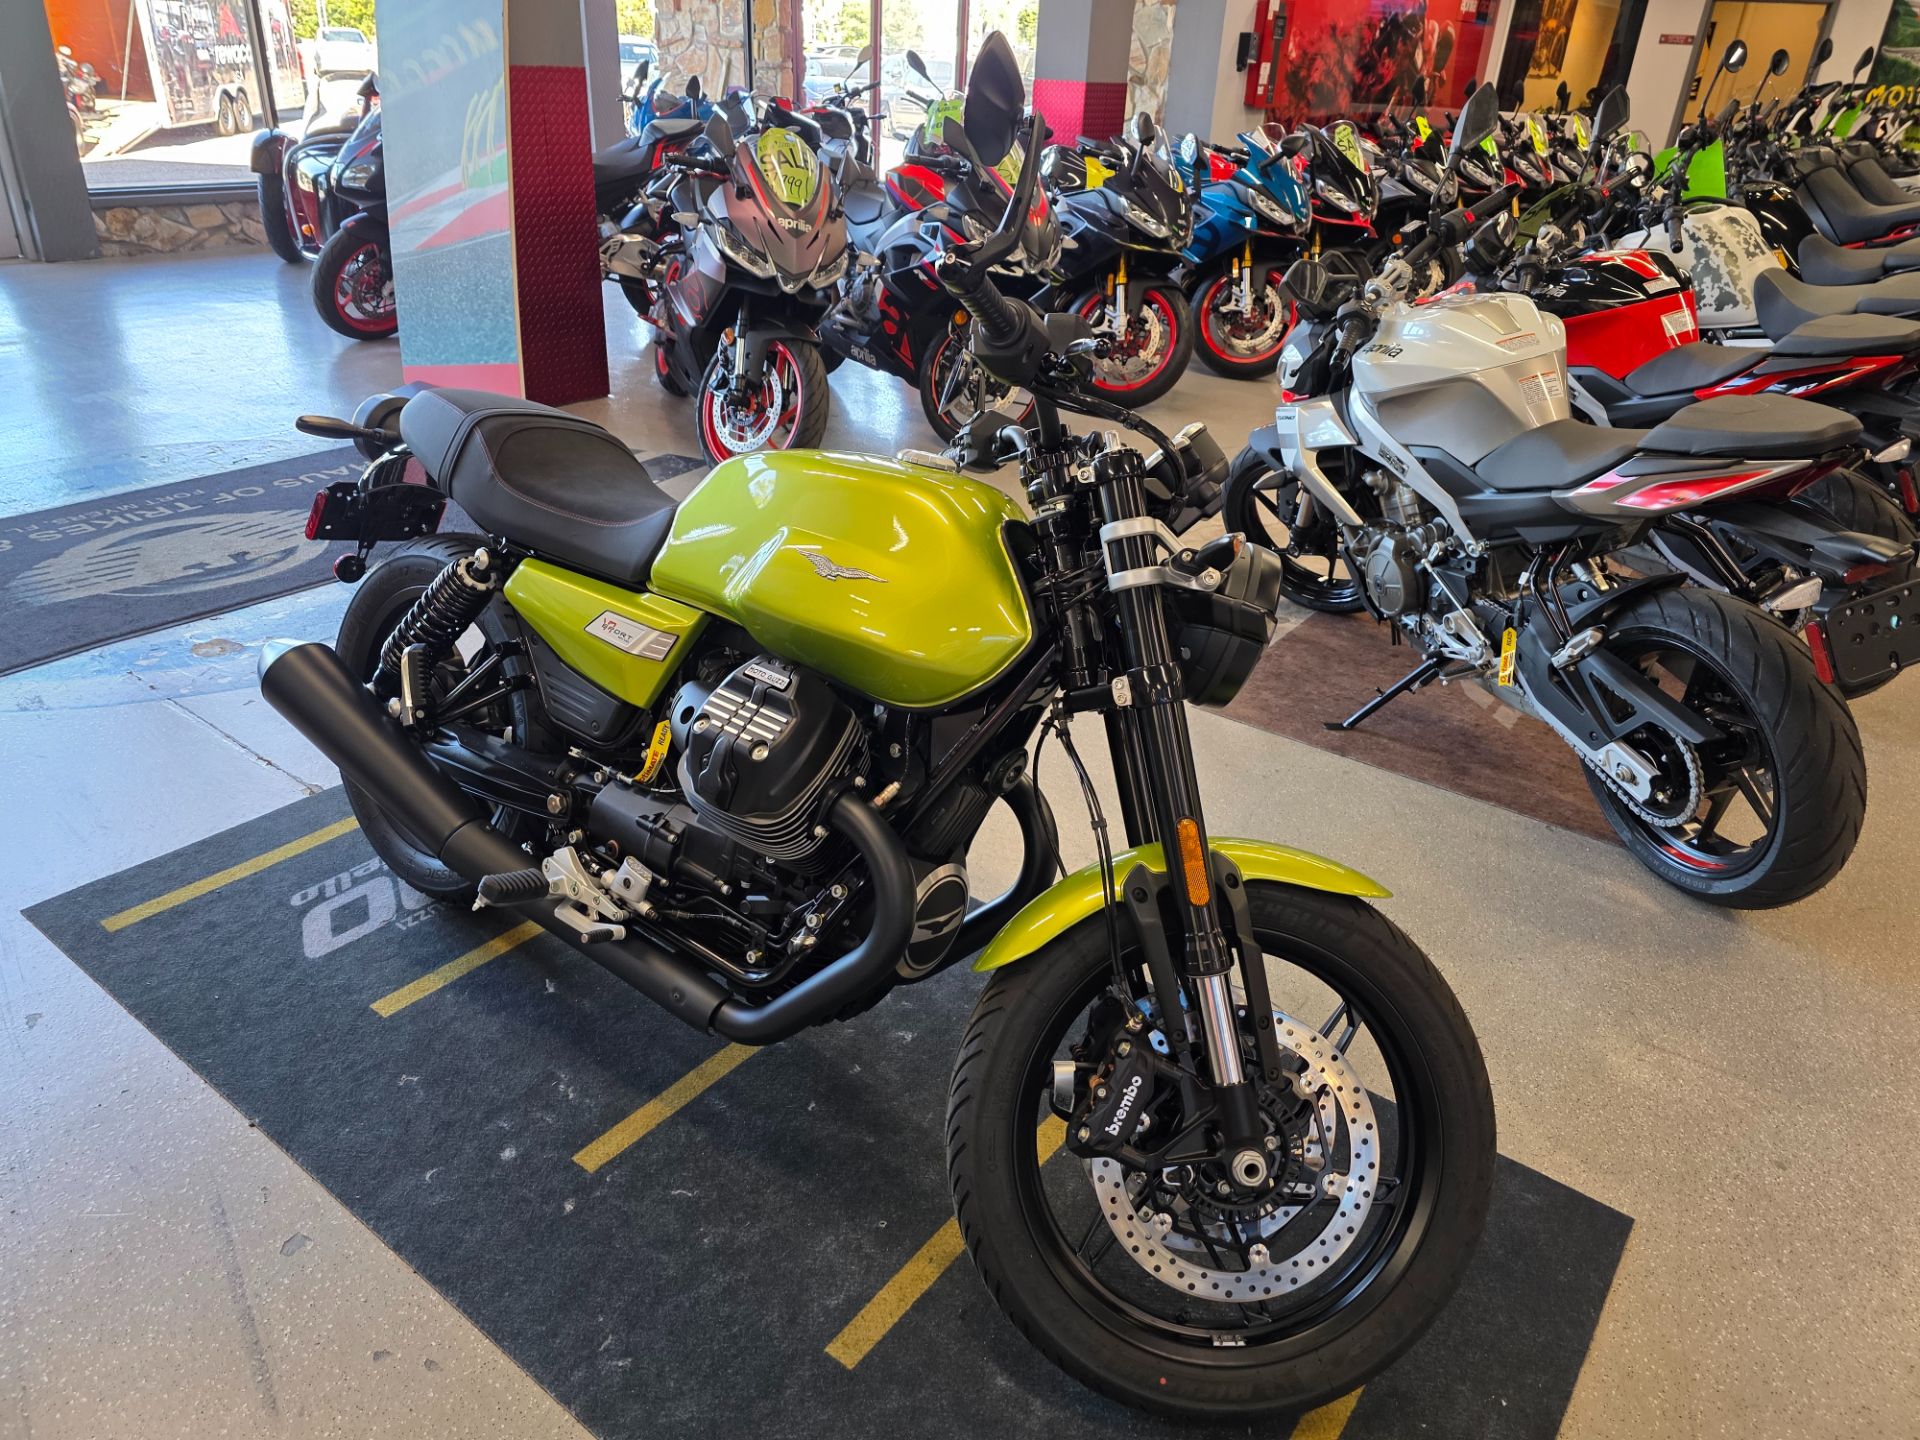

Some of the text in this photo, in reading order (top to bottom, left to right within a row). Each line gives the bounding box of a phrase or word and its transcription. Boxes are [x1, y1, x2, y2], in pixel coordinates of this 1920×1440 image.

[778, 217, 812, 233] aprilia
[850, 343, 877, 367] aprilia
[212, 486, 265, 504] OF
[28, 501, 203, 542] TRIKES
[748, 666, 787, 688] MOTO GUZZI
[657, 724, 669, 746] READY
[1105, 1076, 1142, 1136] brembo
